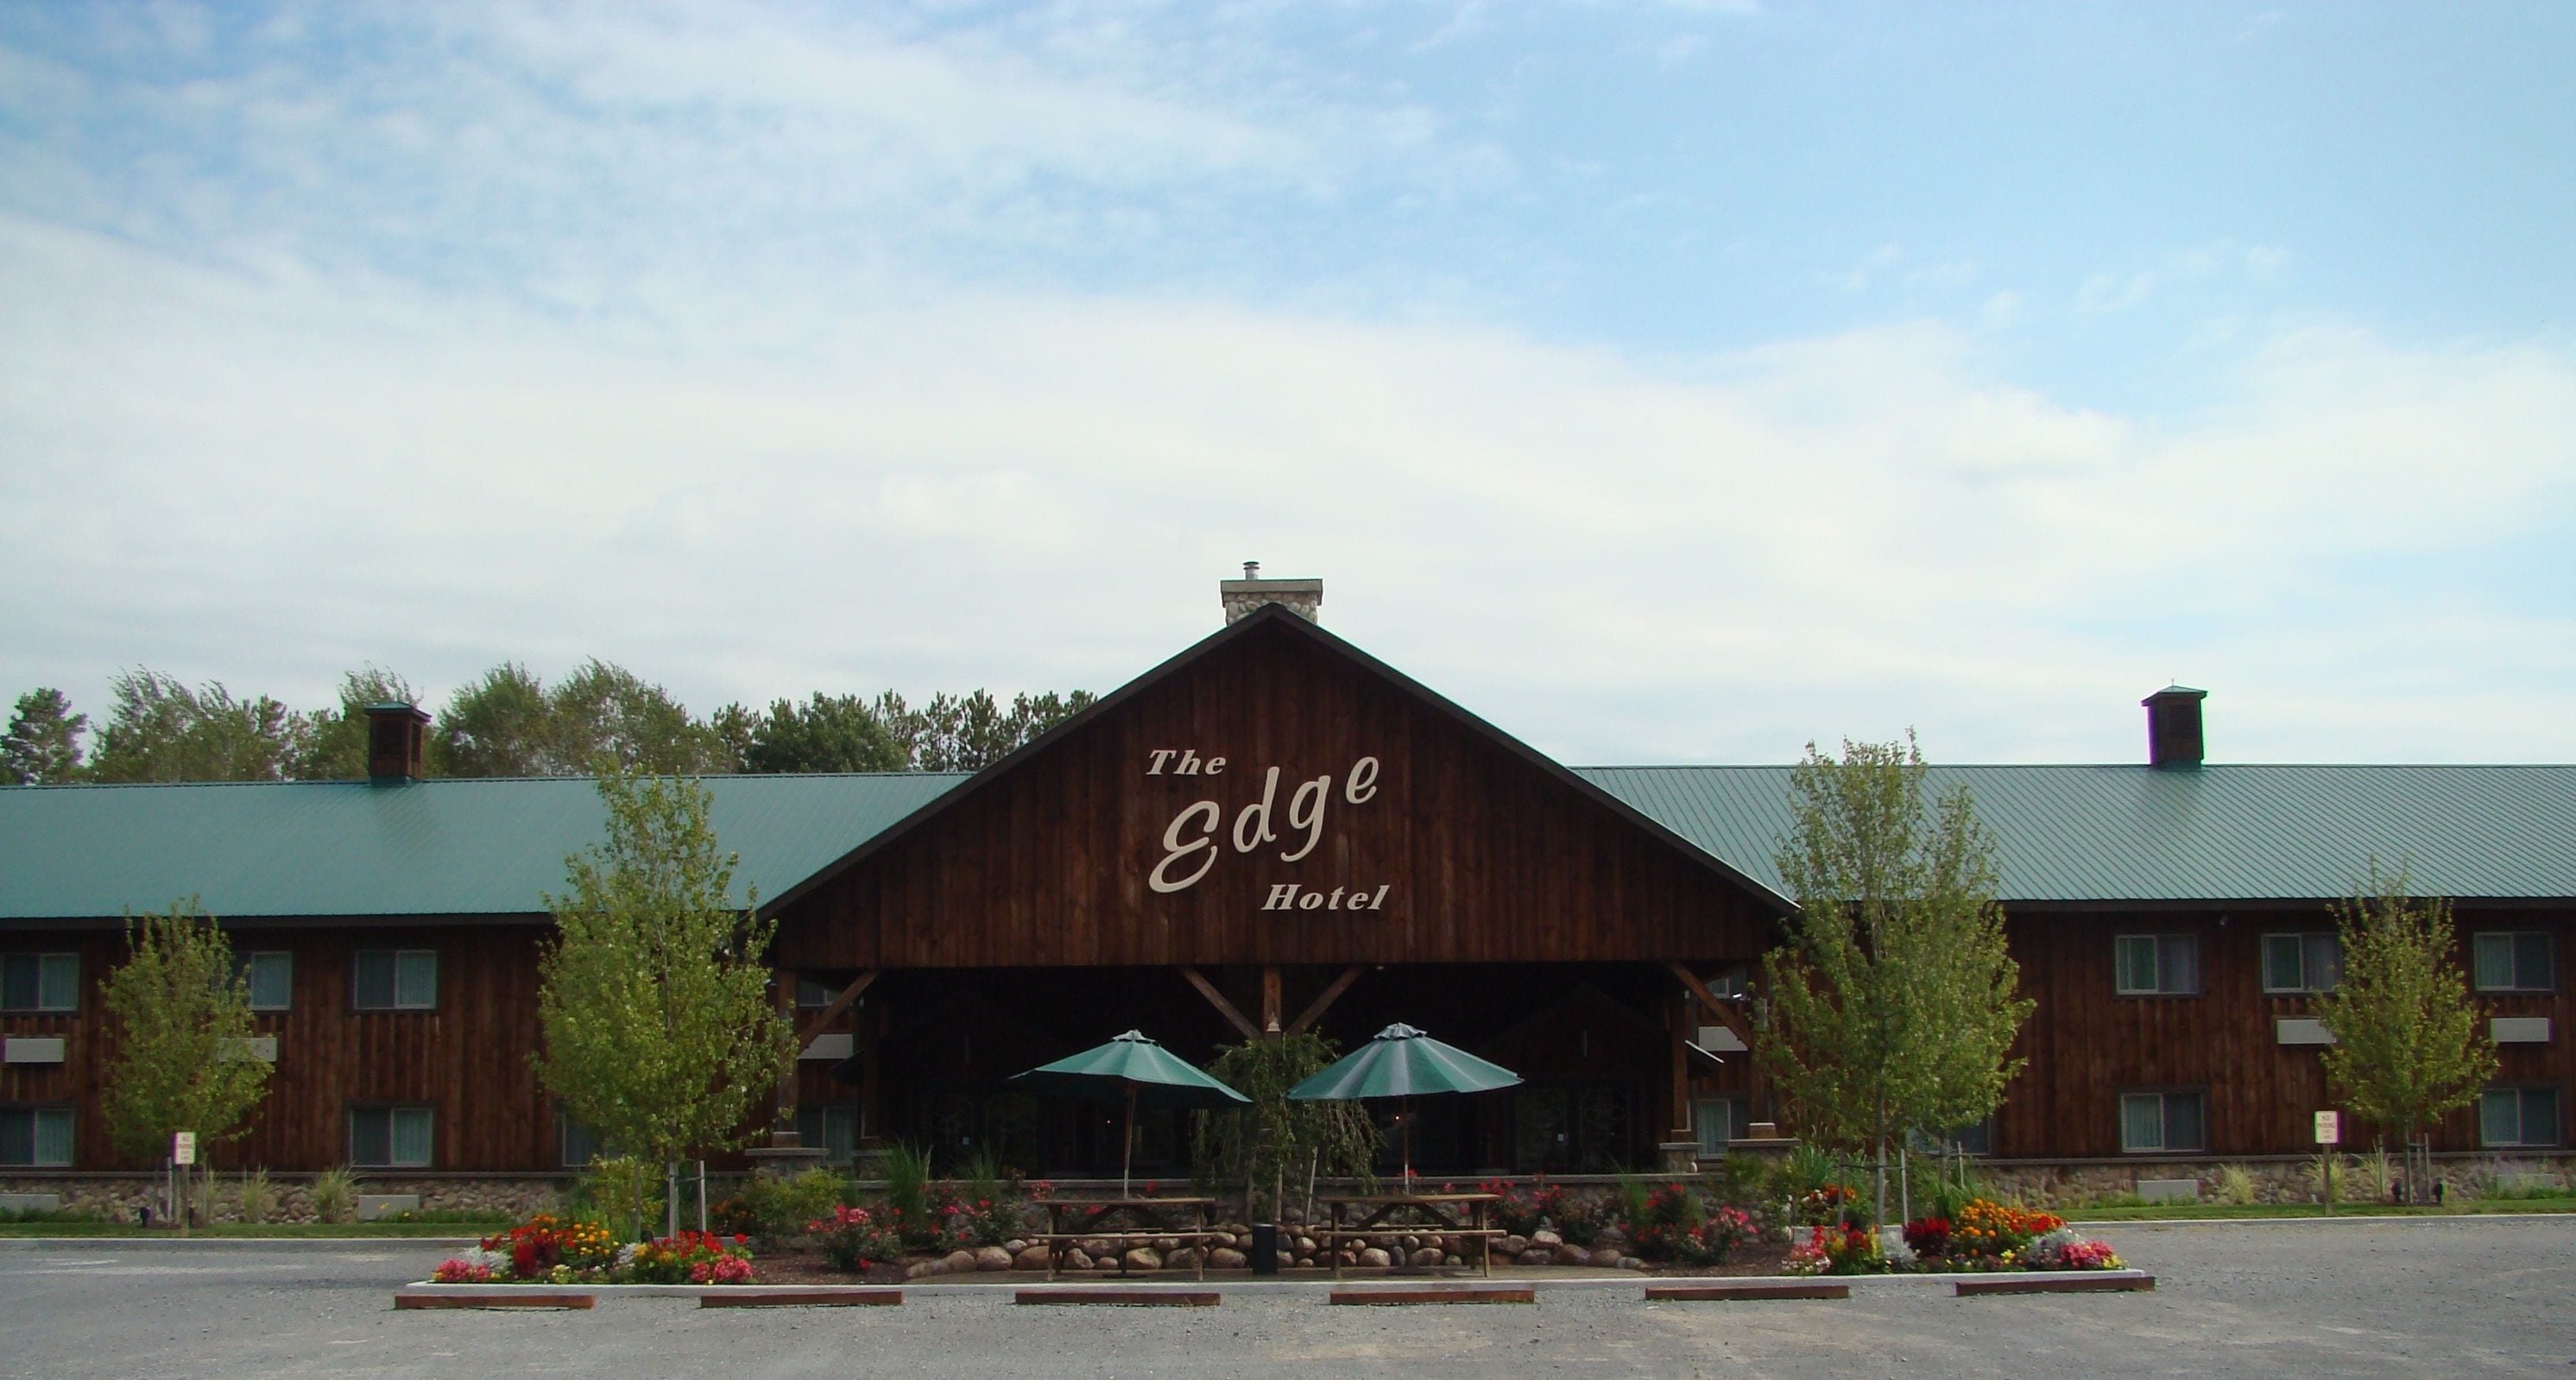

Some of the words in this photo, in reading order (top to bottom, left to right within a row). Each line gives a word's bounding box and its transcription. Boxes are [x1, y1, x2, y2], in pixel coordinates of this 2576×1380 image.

[1146, 749, 1226, 776] The
[1148, 756, 1380, 893] Edge
[1260, 884, 1391, 911] Hotel
